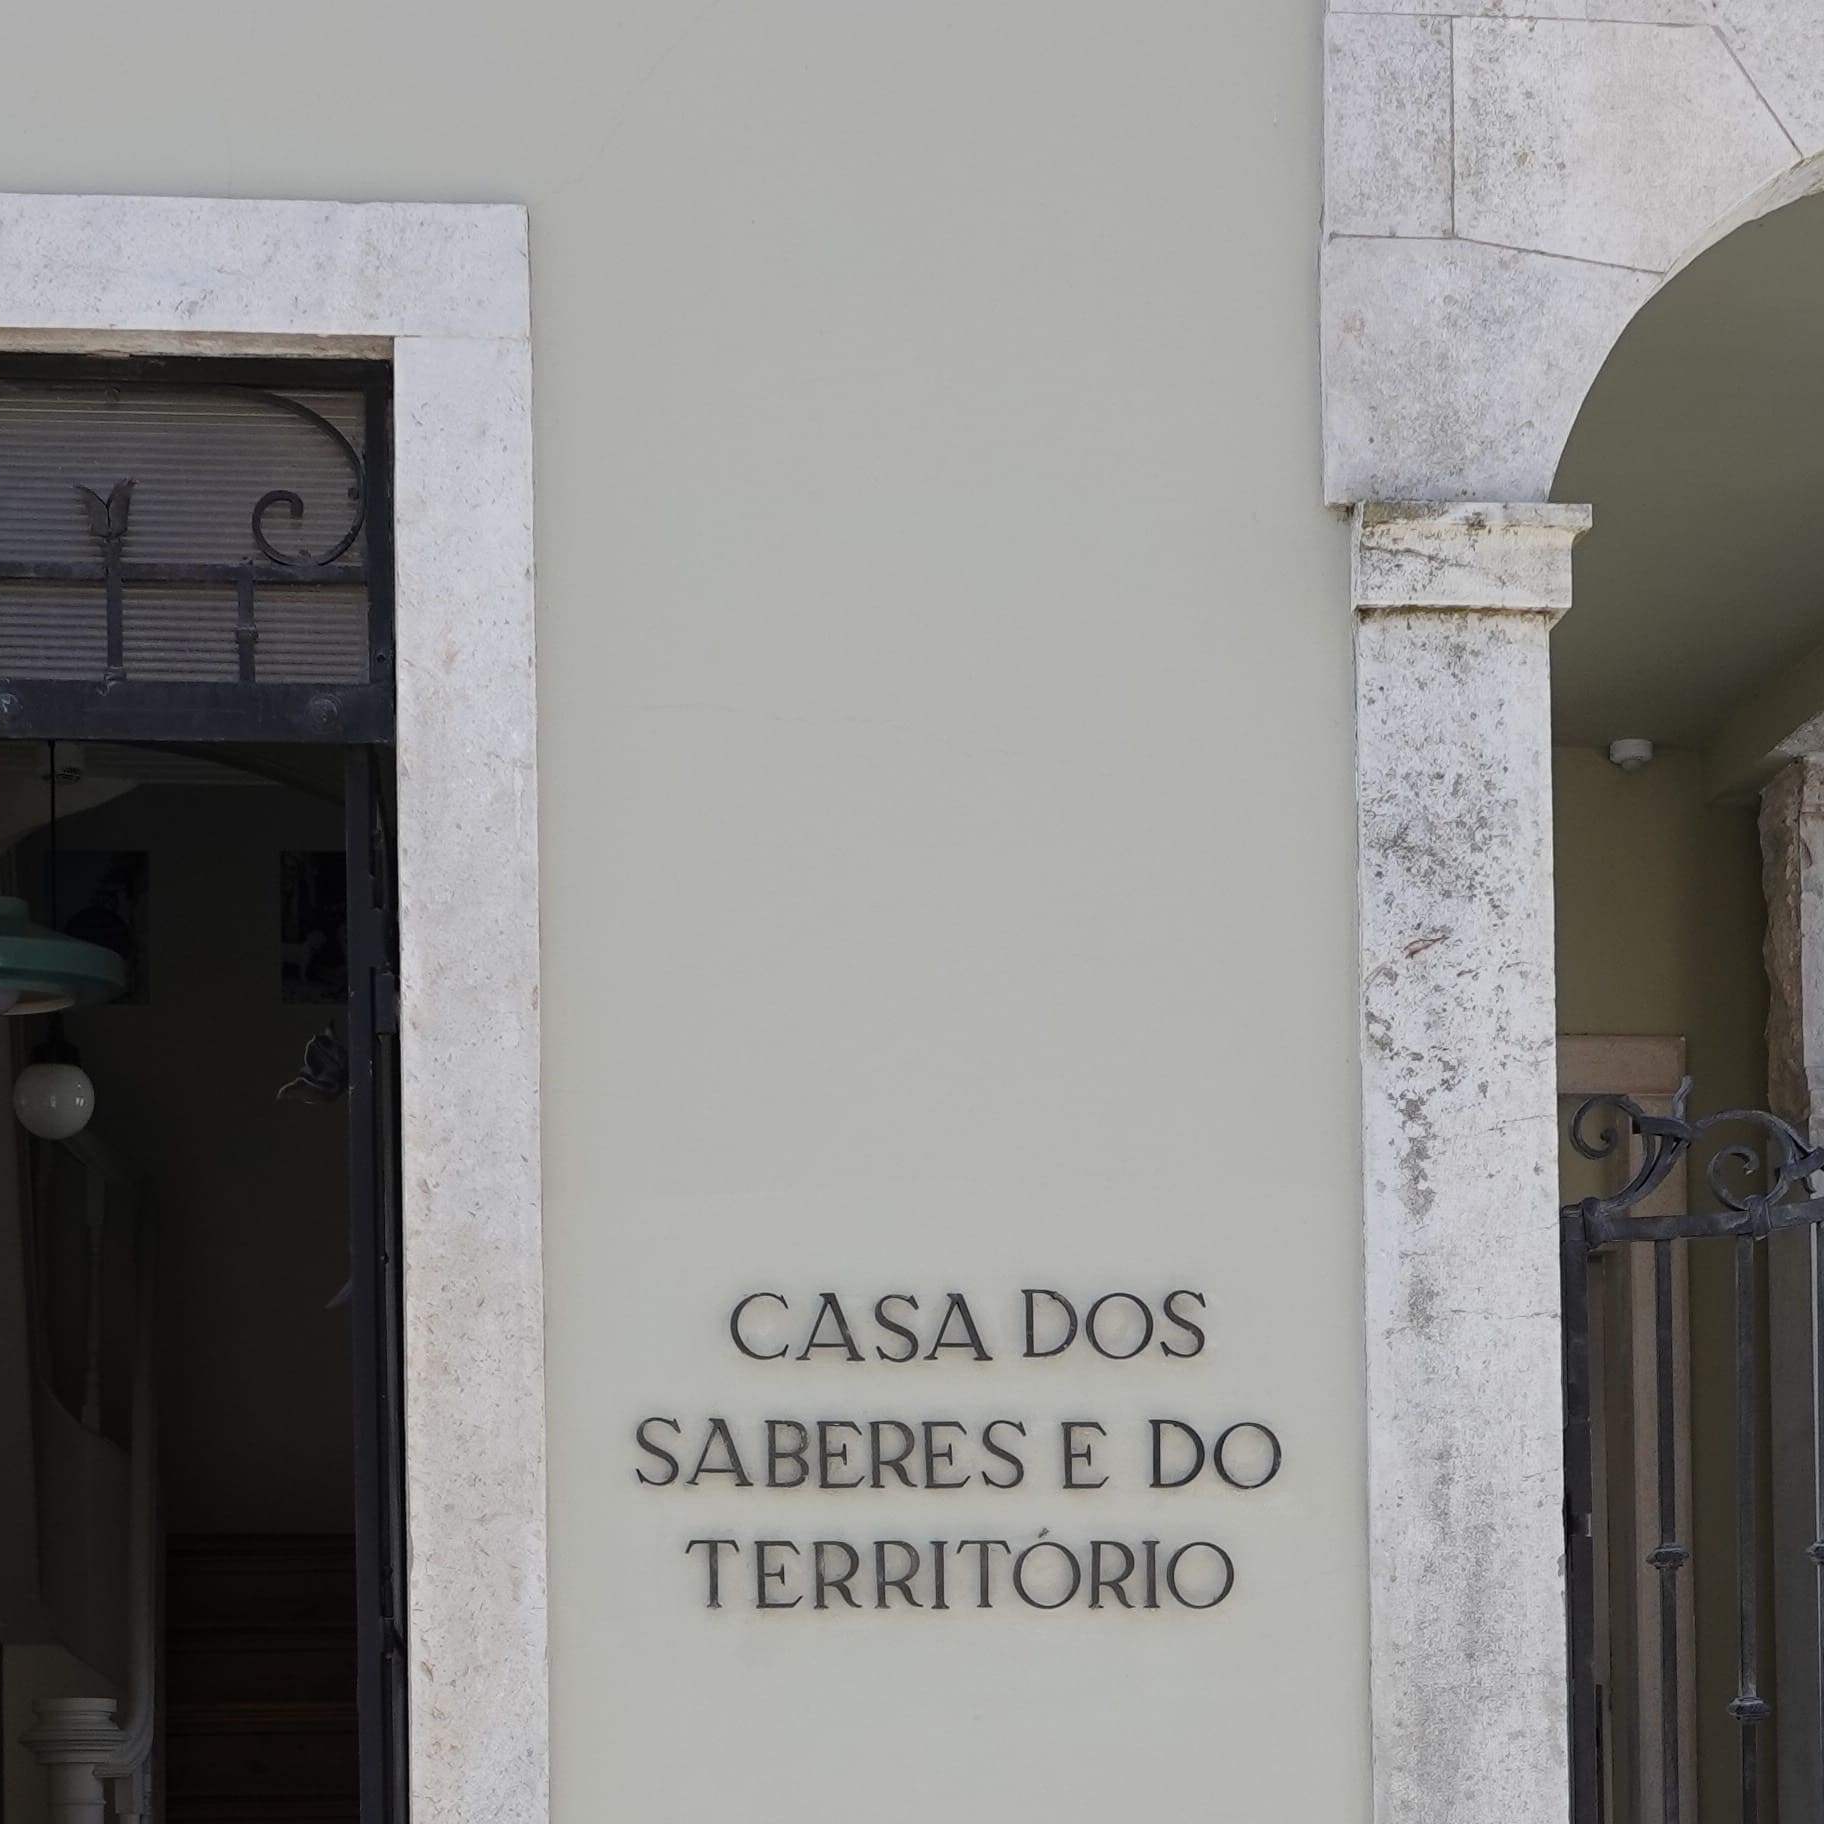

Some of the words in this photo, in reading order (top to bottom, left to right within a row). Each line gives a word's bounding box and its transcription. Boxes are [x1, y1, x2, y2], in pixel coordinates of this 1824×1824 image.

[729, 1292, 994, 1362] CASA
[1020, 1288, 1207, 1360] DOS
[635, 1416, 1028, 1489] SABERES
[1062, 1421, 1110, 1490] E
[1148, 1418, 1283, 1490] DO
[685, 1527, 1236, 1610] TERRITÓRIO
